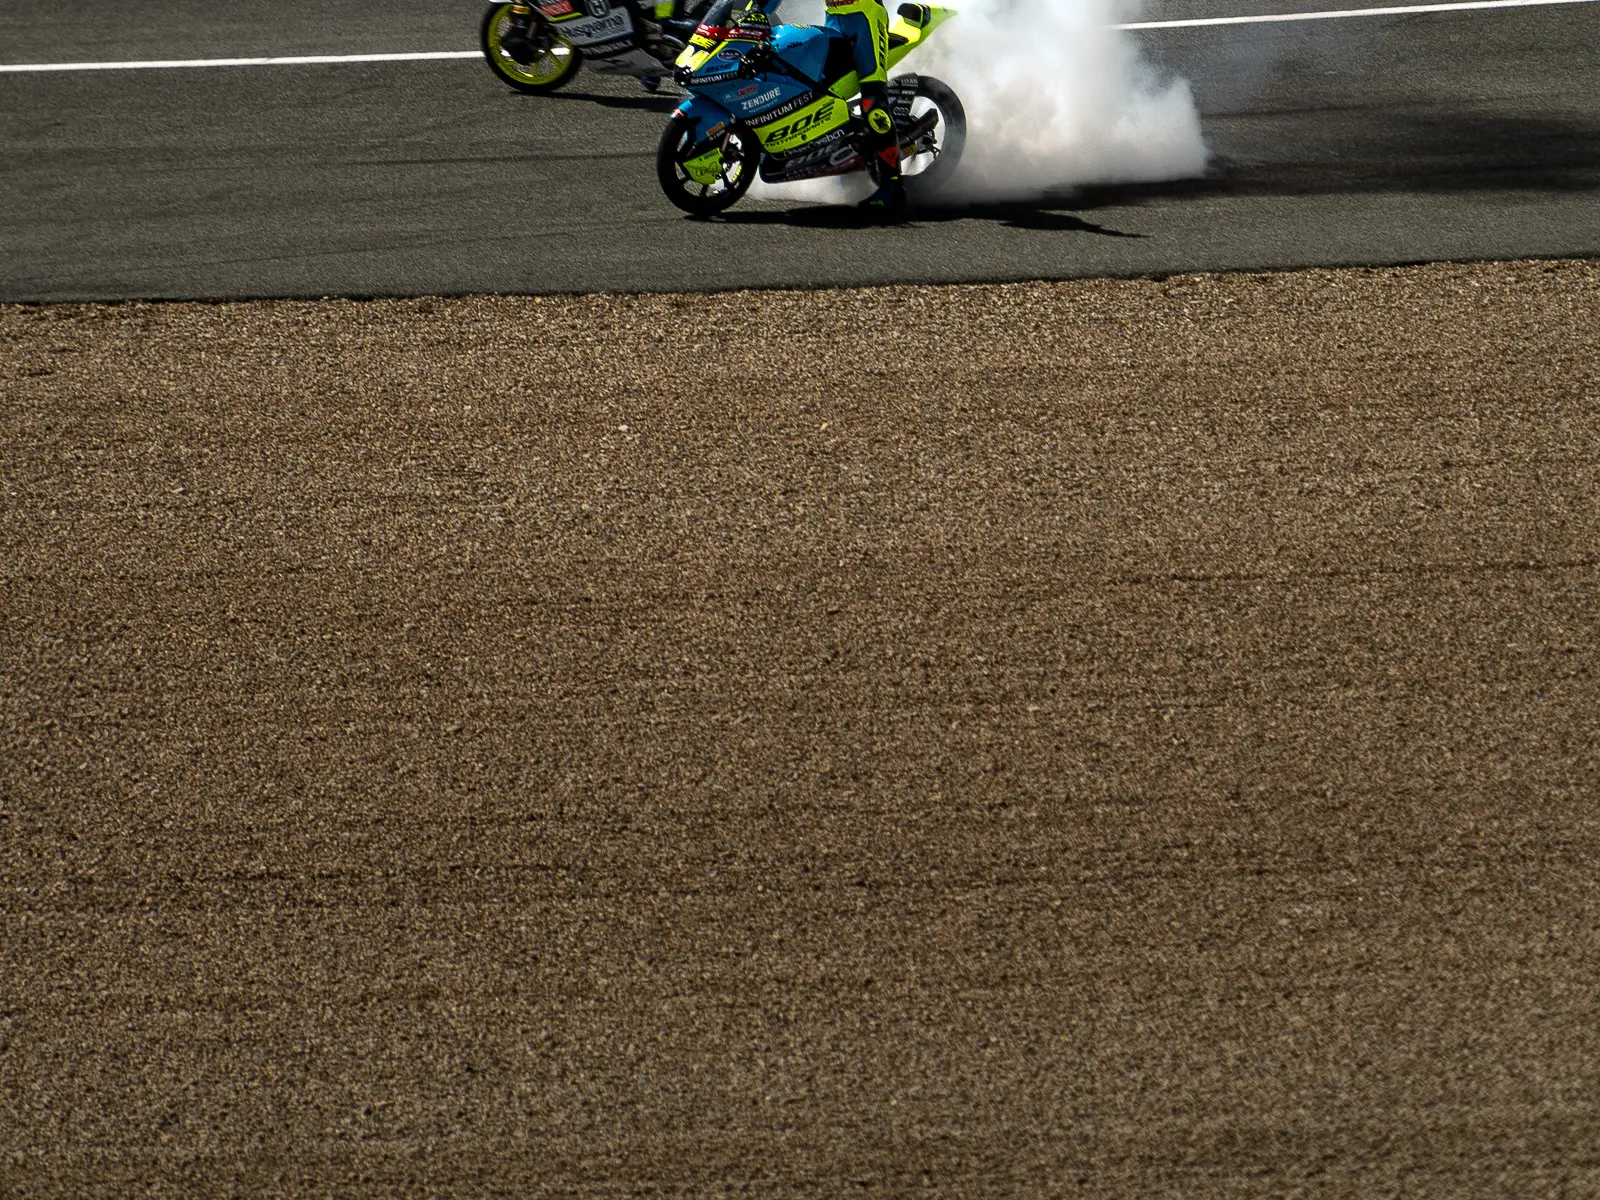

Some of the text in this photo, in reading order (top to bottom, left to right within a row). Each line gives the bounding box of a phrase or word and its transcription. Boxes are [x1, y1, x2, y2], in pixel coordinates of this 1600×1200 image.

[690, 73, 723, 86] INFINITUM
[741, 87, 781, 110] ZENDURE
[744, 102, 793, 127] INFINITUM
[793, 91, 813, 108] FEST
[764, 98, 836, 143] BOE
